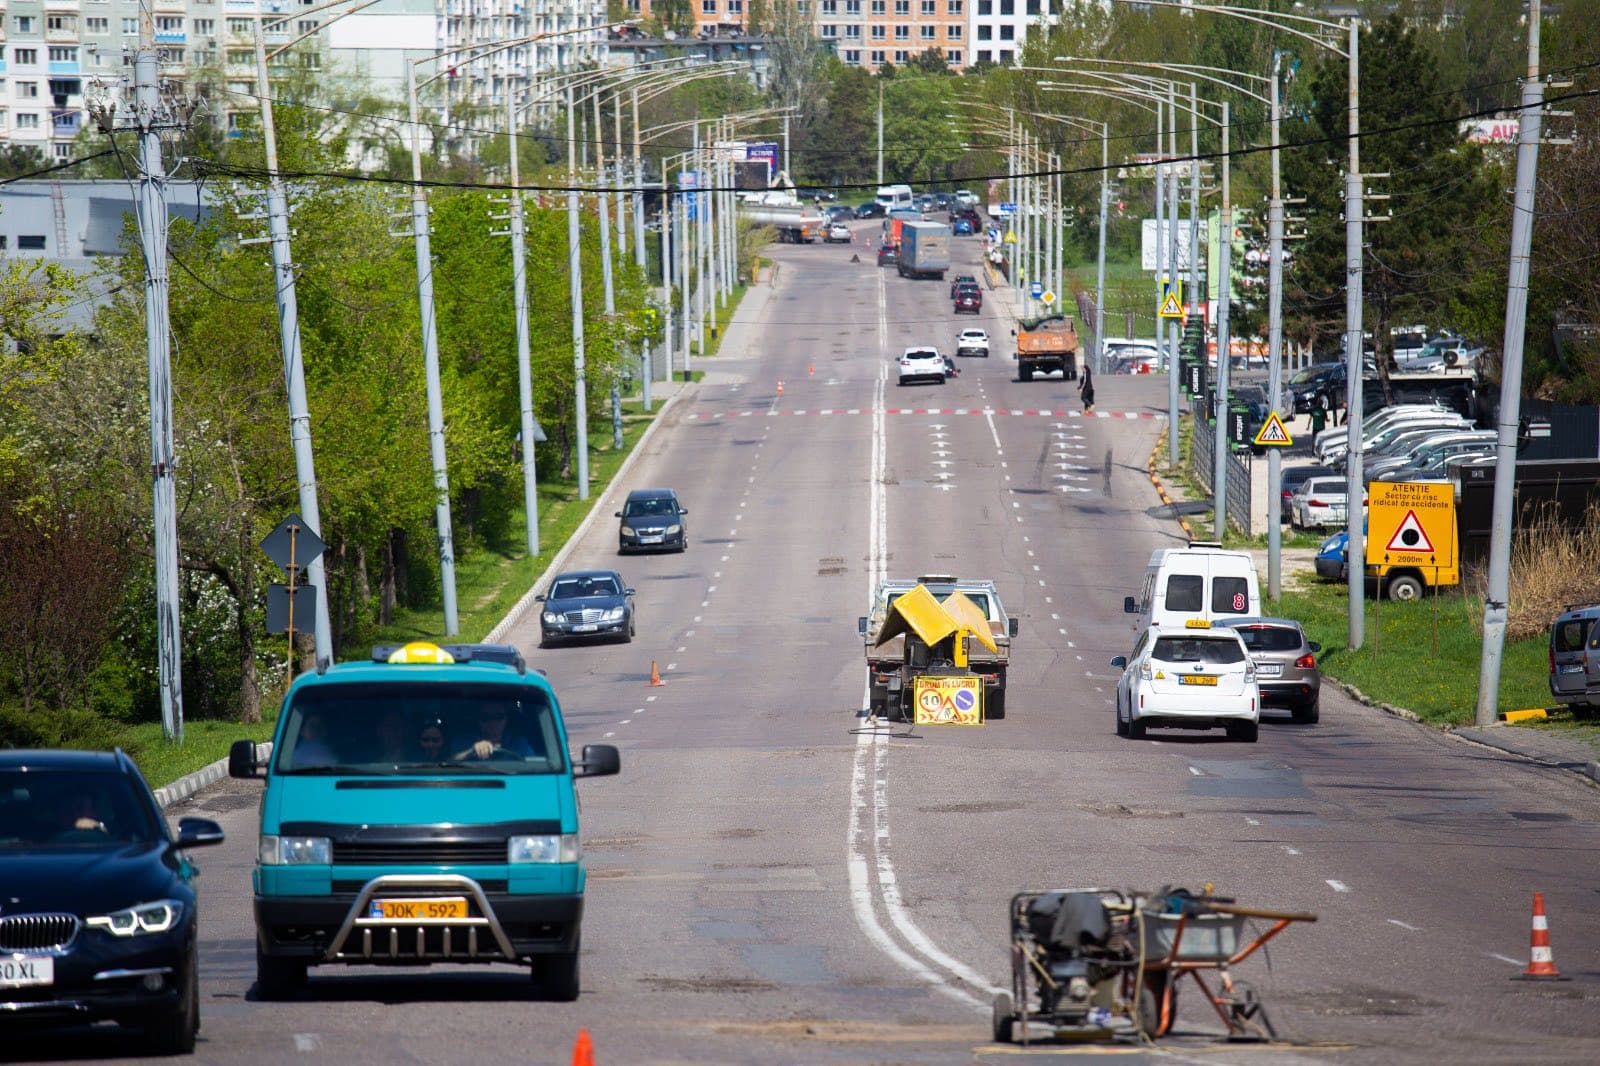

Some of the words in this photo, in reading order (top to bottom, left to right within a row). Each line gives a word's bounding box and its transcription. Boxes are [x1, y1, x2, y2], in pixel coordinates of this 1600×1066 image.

[1385, 492, 1410, 500] Sector
[1373, 499, 1398, 507] ridicat
[1233, 592, 1245, 611] 8
[922, 695, 939, 706] 10
[385, 903, 415, 918] JOK
[428, 904, 457, 917] 592
[0, 962, 14, 980] 0
[19, 962, 39, 979] XL
